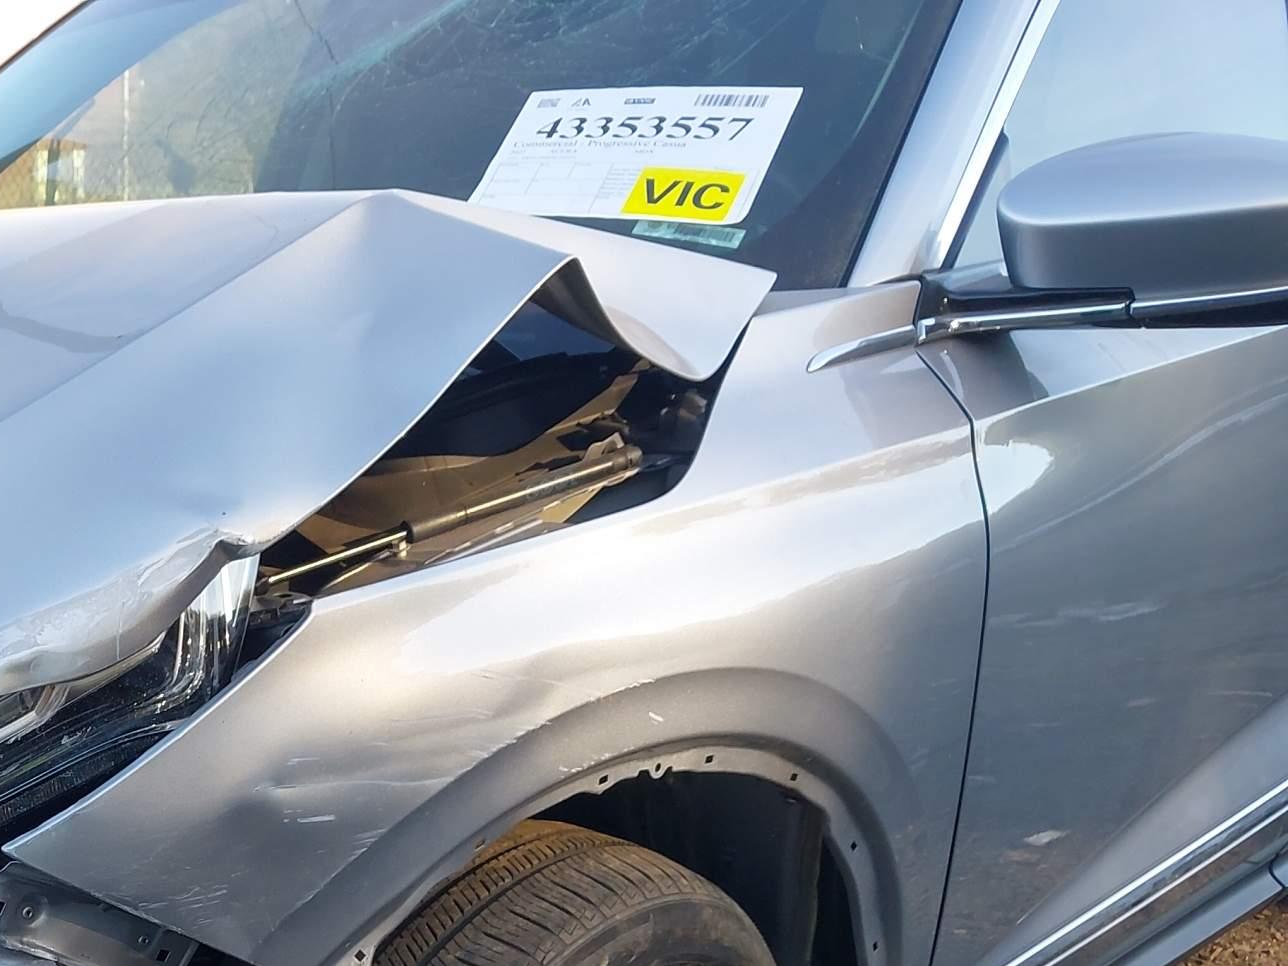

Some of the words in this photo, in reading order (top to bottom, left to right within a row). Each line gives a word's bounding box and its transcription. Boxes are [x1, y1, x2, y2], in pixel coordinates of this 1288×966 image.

[536, 115, 755, 142] 43353557
[587, 140, 649, 149] Progressive
[644, 177, 731, 211] VIC
